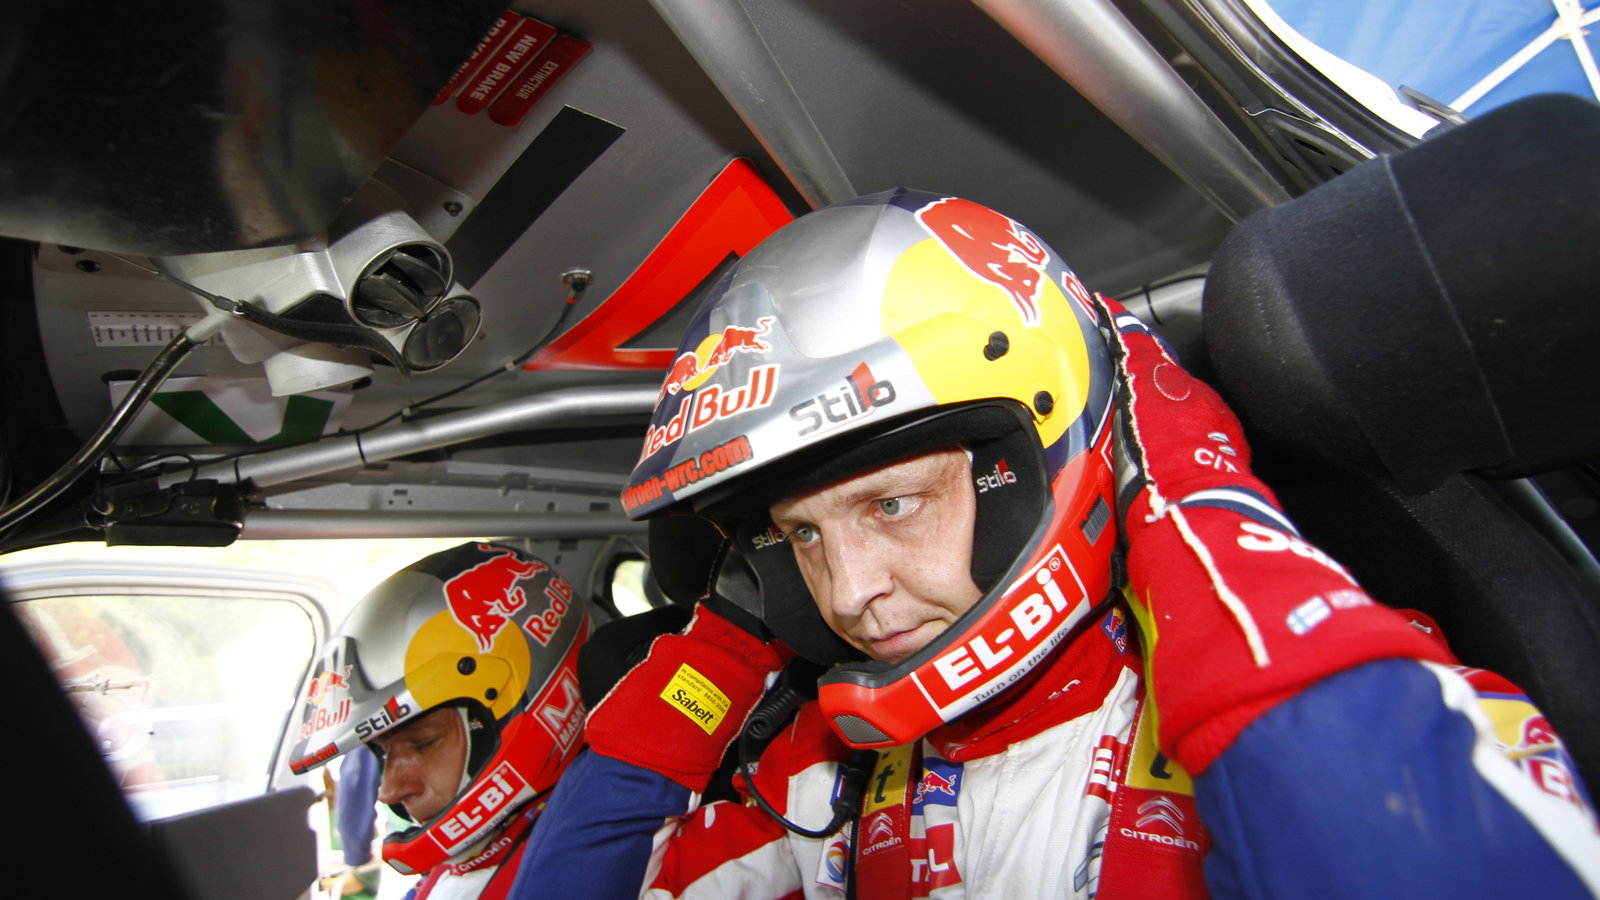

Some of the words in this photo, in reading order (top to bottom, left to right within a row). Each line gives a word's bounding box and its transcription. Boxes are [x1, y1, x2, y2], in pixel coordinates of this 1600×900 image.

[506, 34, 538, 63] NEW
[470, 62, 511, 101] BRAKE
[515, 60, 559, 100] EXTINCTEUR
[690, 364, 780, 432] Bull
[789, 362, 897, 438] Stilo
[523, 587, 569, 647] Red
[677, 674, 702, 693] standard
[686, 671, 714, 694] compliance
[973, 681, 1006, 704] Turn
[1009, 667, 1026, 682] on
[1027, 645, 1049, 669] the
[316, 699, 352, 732] Bull
[355, 696, 411, 740] Stilo
[672, 689, 714, 724] Sabelt
